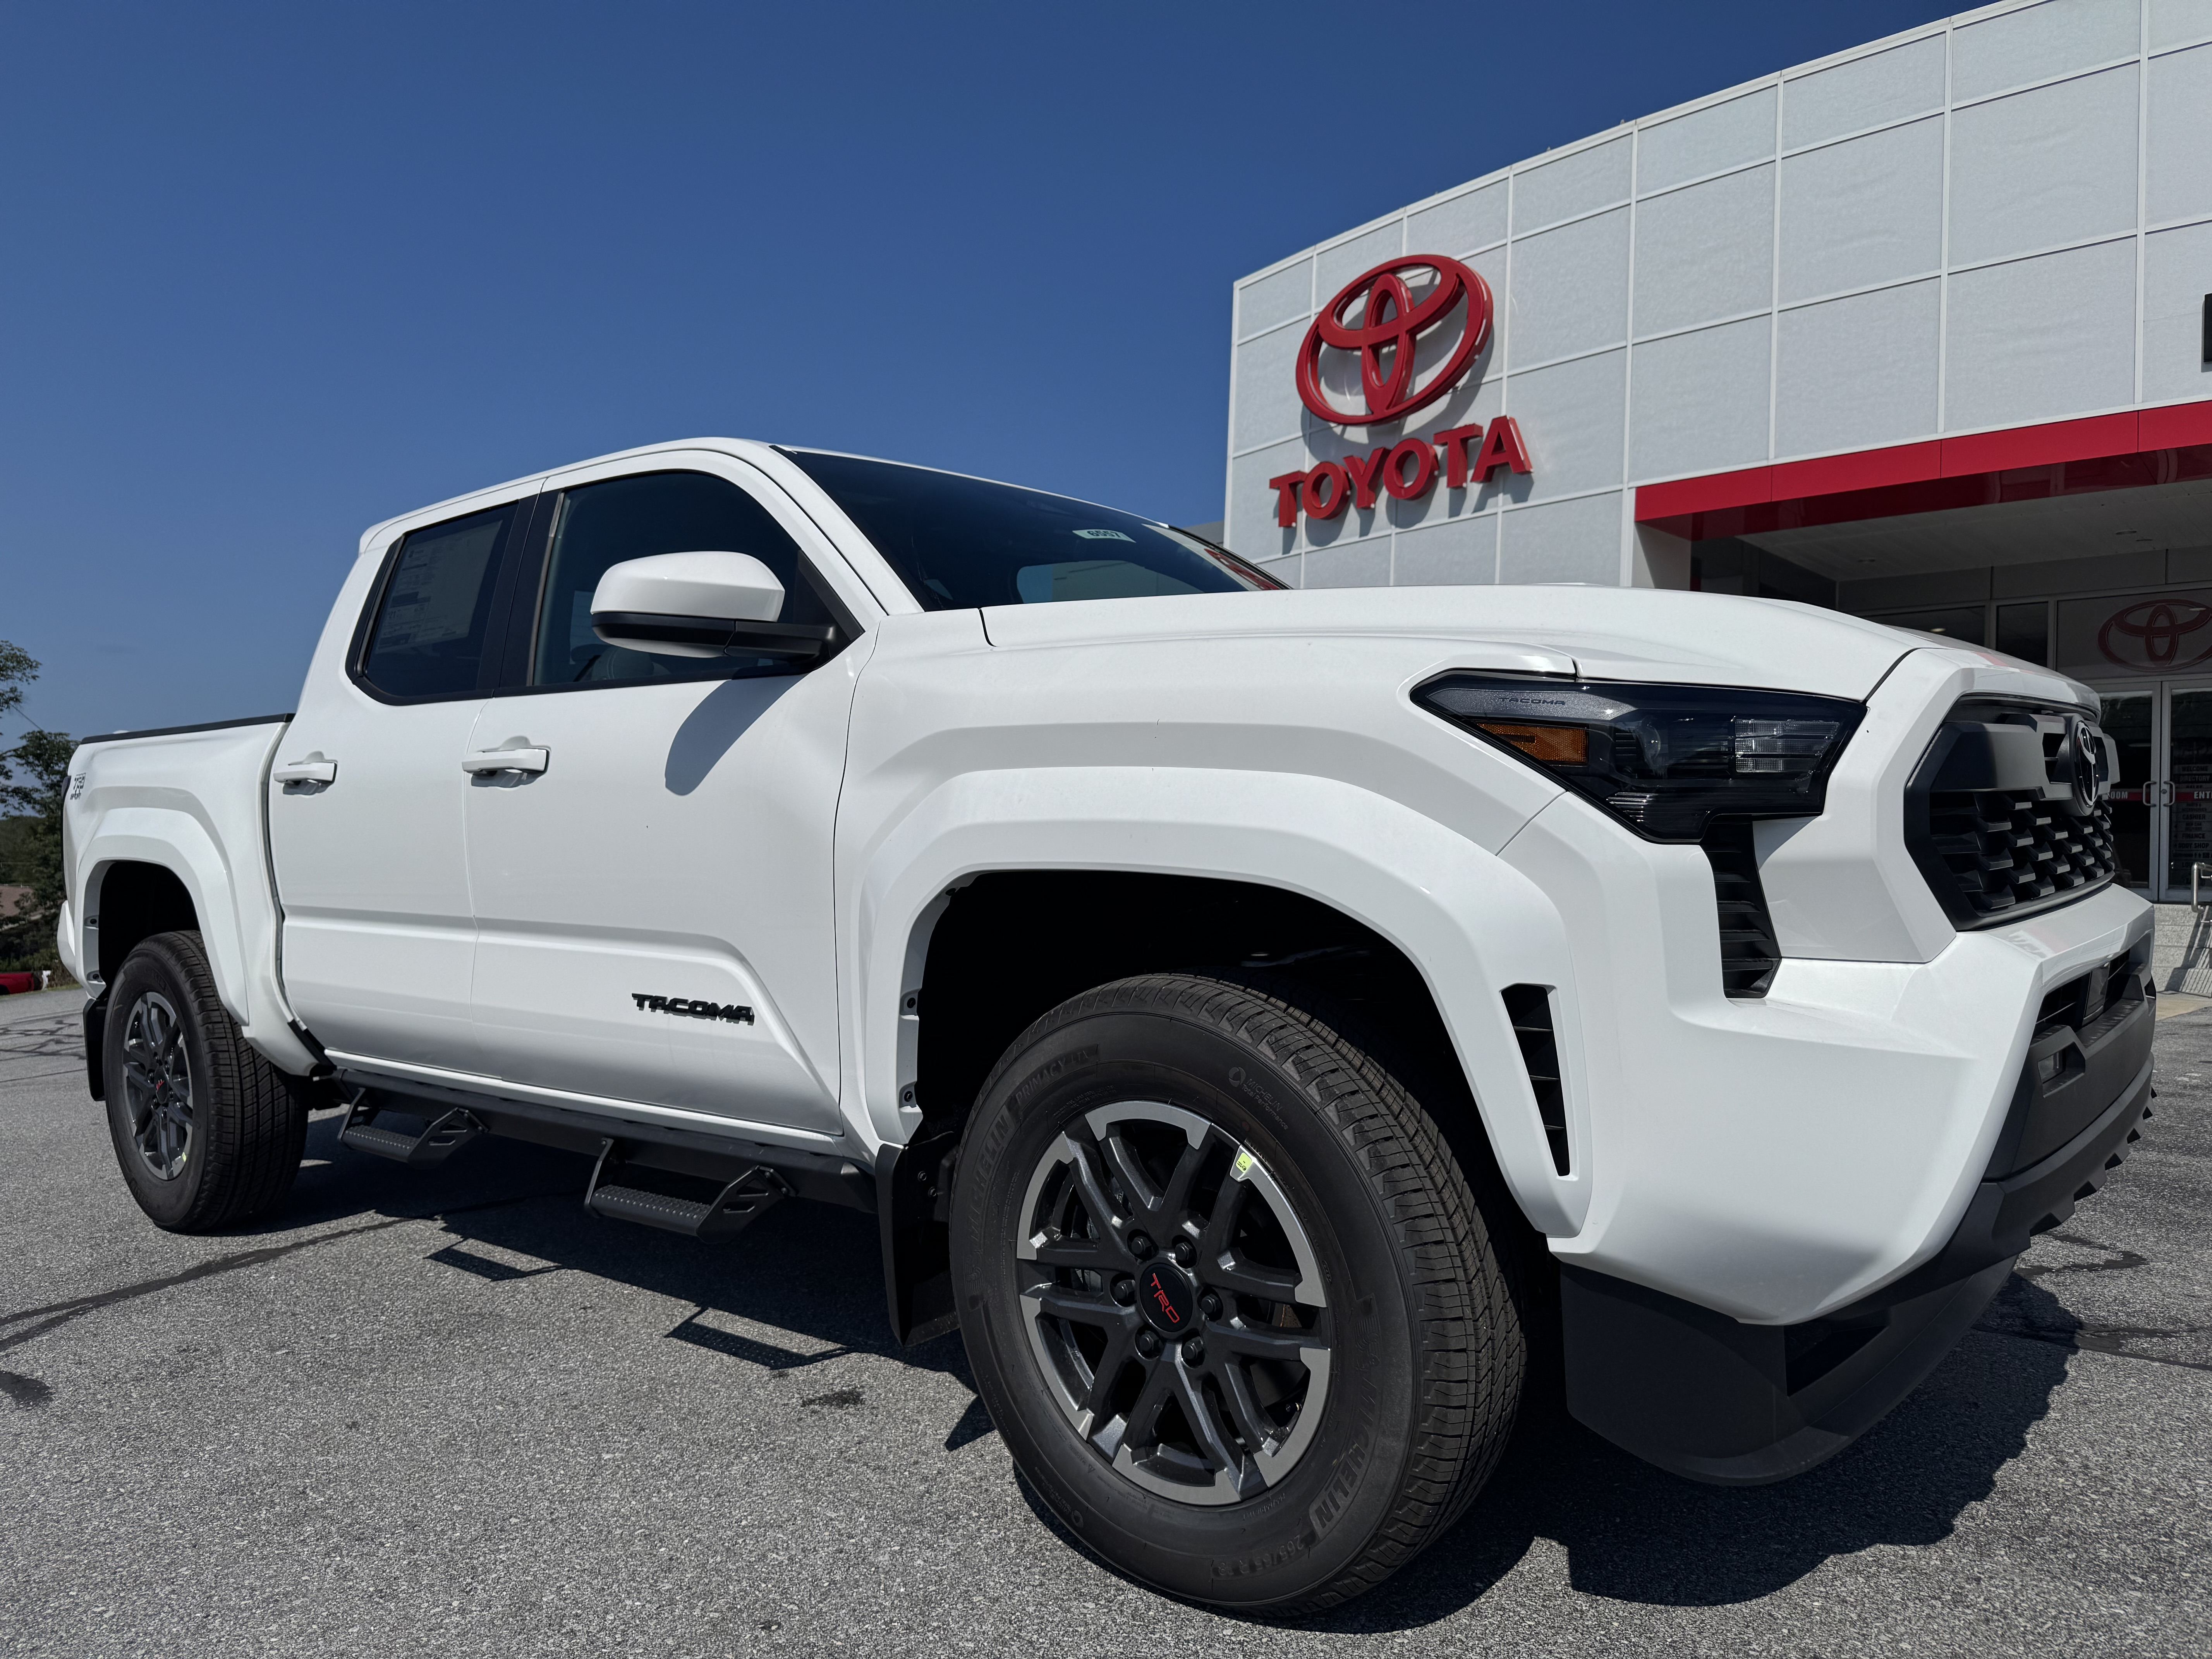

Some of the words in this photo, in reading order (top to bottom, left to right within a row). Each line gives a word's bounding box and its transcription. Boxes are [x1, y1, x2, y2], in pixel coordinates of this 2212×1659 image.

[1269, 415, 1534, 528] TOYOTA
[1498, 697, 1566, 706] TACOMA
[631, 993, 755, 1025] TACOMA
[1015, 1058, 1066, 1106] PRIMACY
[1246, 1079, 1283, 1111] MICHELIN
[1242, 1084, 1256, 1097] Total
[1254, 1095, 1289, 1130] Performance
[969, 1113, 1012, 1242] MICHELIN
[1151, 1273, 1180, 1323] TRD
[1314, 1377, 1377, 1529] MICHELIN
